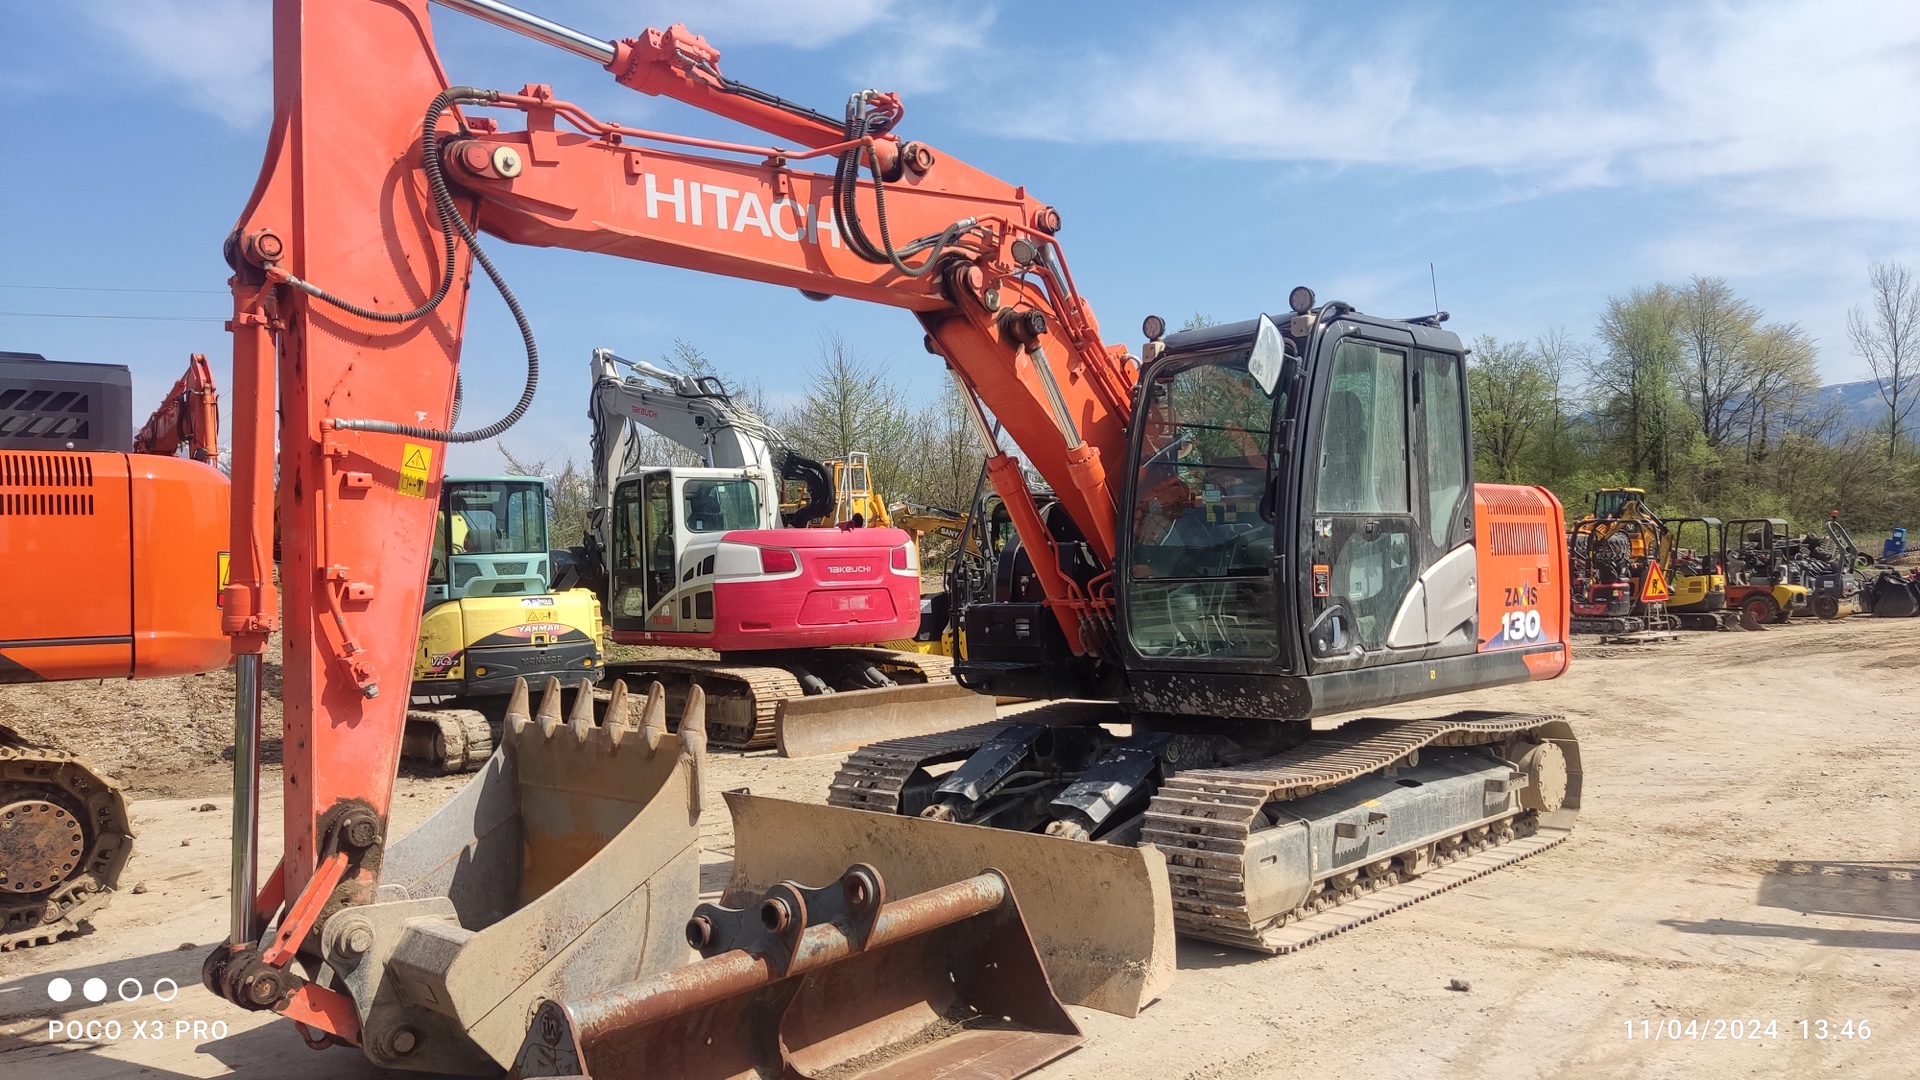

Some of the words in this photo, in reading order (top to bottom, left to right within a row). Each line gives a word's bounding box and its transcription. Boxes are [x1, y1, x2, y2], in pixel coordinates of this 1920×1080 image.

[645, 173, 849, 249] HITACH
[940, 527, 959, 538] SANY
[1505, 582, 1537, 606] ZAXIS
[518, 624, 560, 633] YANMAR
[1501, 609, 1540, 641] 130
